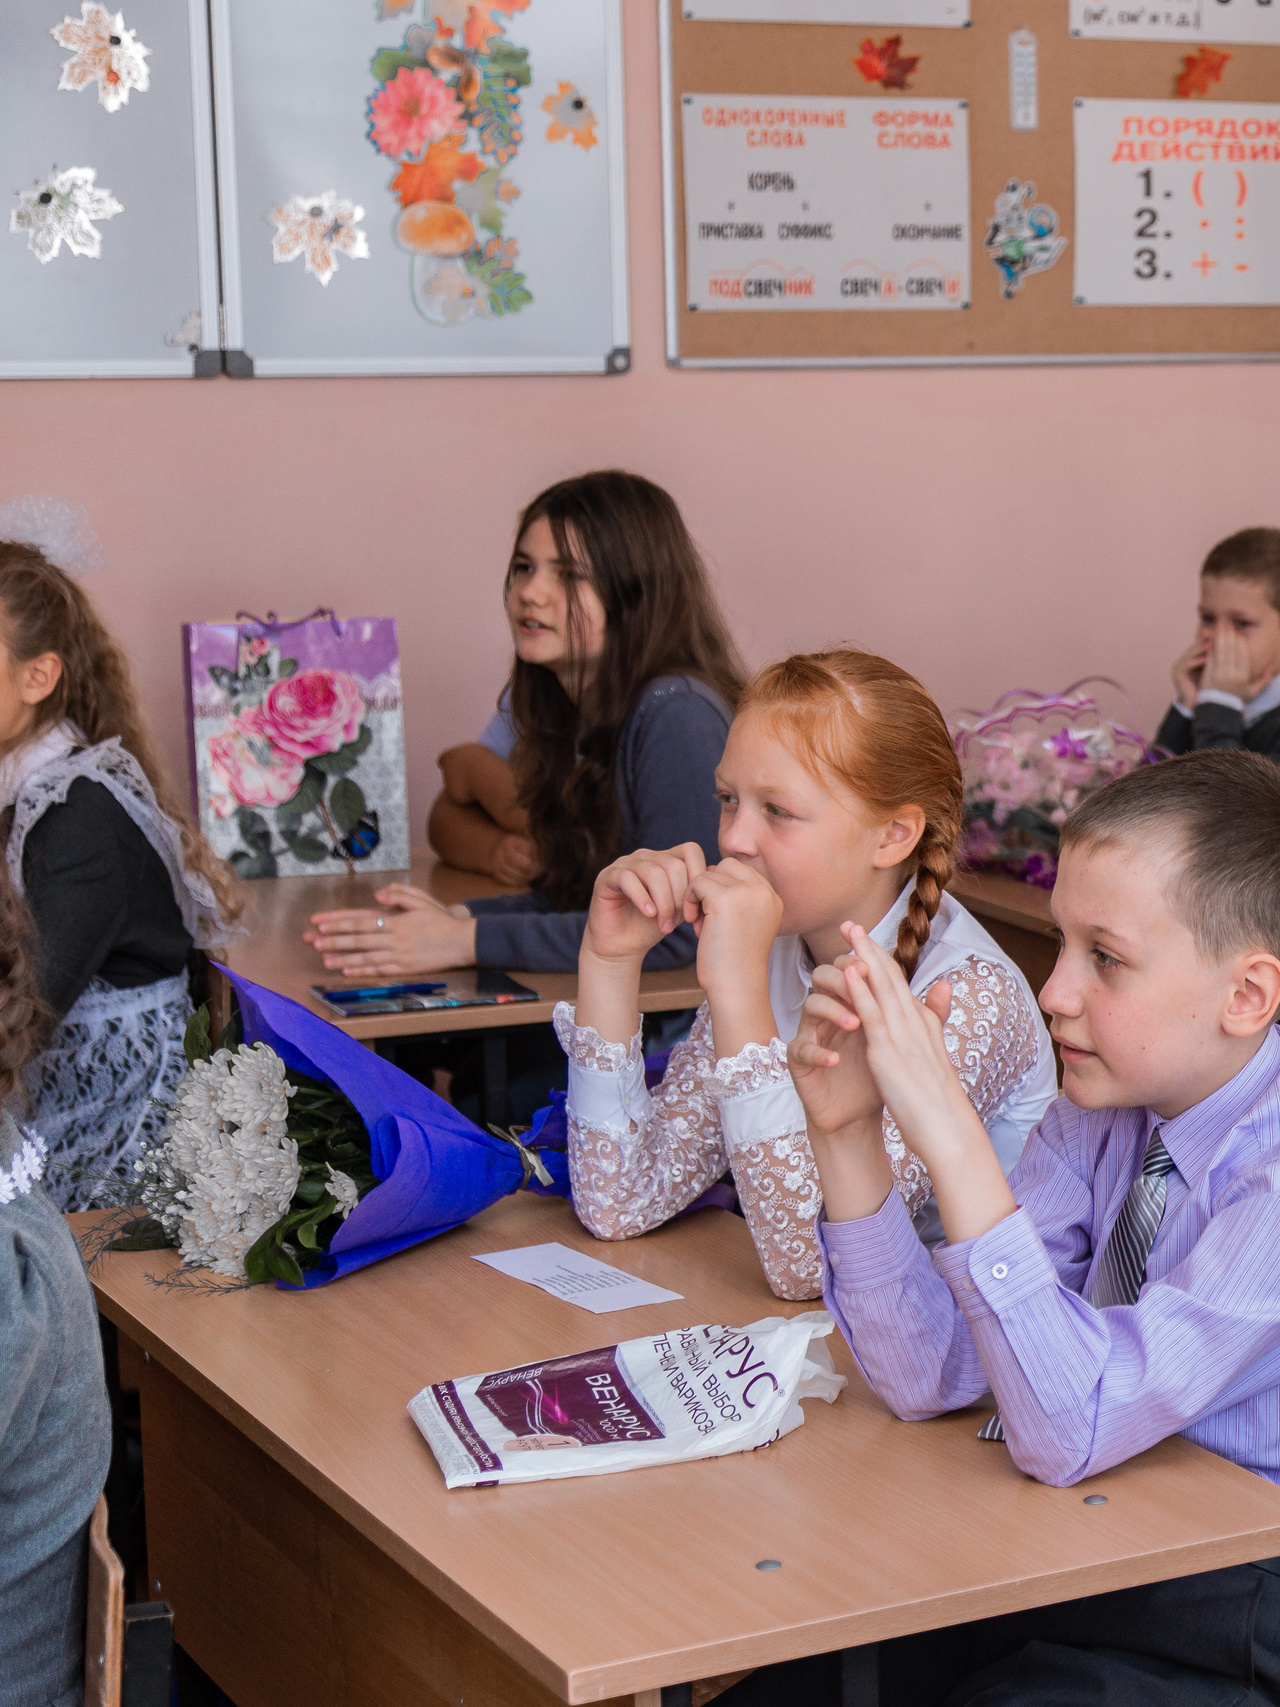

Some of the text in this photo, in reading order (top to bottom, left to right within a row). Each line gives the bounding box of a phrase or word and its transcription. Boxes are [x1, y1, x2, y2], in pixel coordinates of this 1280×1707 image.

[701, 106, 848, 129] ОДНОКОРЕННЫЕ
[872, 109, 955, 128] ФОРМА
[746, 129, 807, 149] СЛОВА
[876, 130, 953, 149] СЛОВА
[747, 171, 796, 193] КОРЕНЬ
[1137, 167, 1173, 198] 1.
[698, 222, 764, 240] ПРИСТАВКА
[777, 222, 833, 240] СУФФИКС
[892, 223, 962, 241] ОКОНЧАНИЕ
[1134, 207, 1173, 239] 2.
[1134, 248, 1173, 279] 3.
[708, 277, 816, 298] ПОДСВЕЧНИК
[484, 1367, 543, 1389] ВЕНАРУС
[585, 1373, 651, 1438] ВЕНАРУС
[670, 1372, 717, 1436] ВАРИКОЗА
[702, 1373, 742, 1423] ВЫБОР
